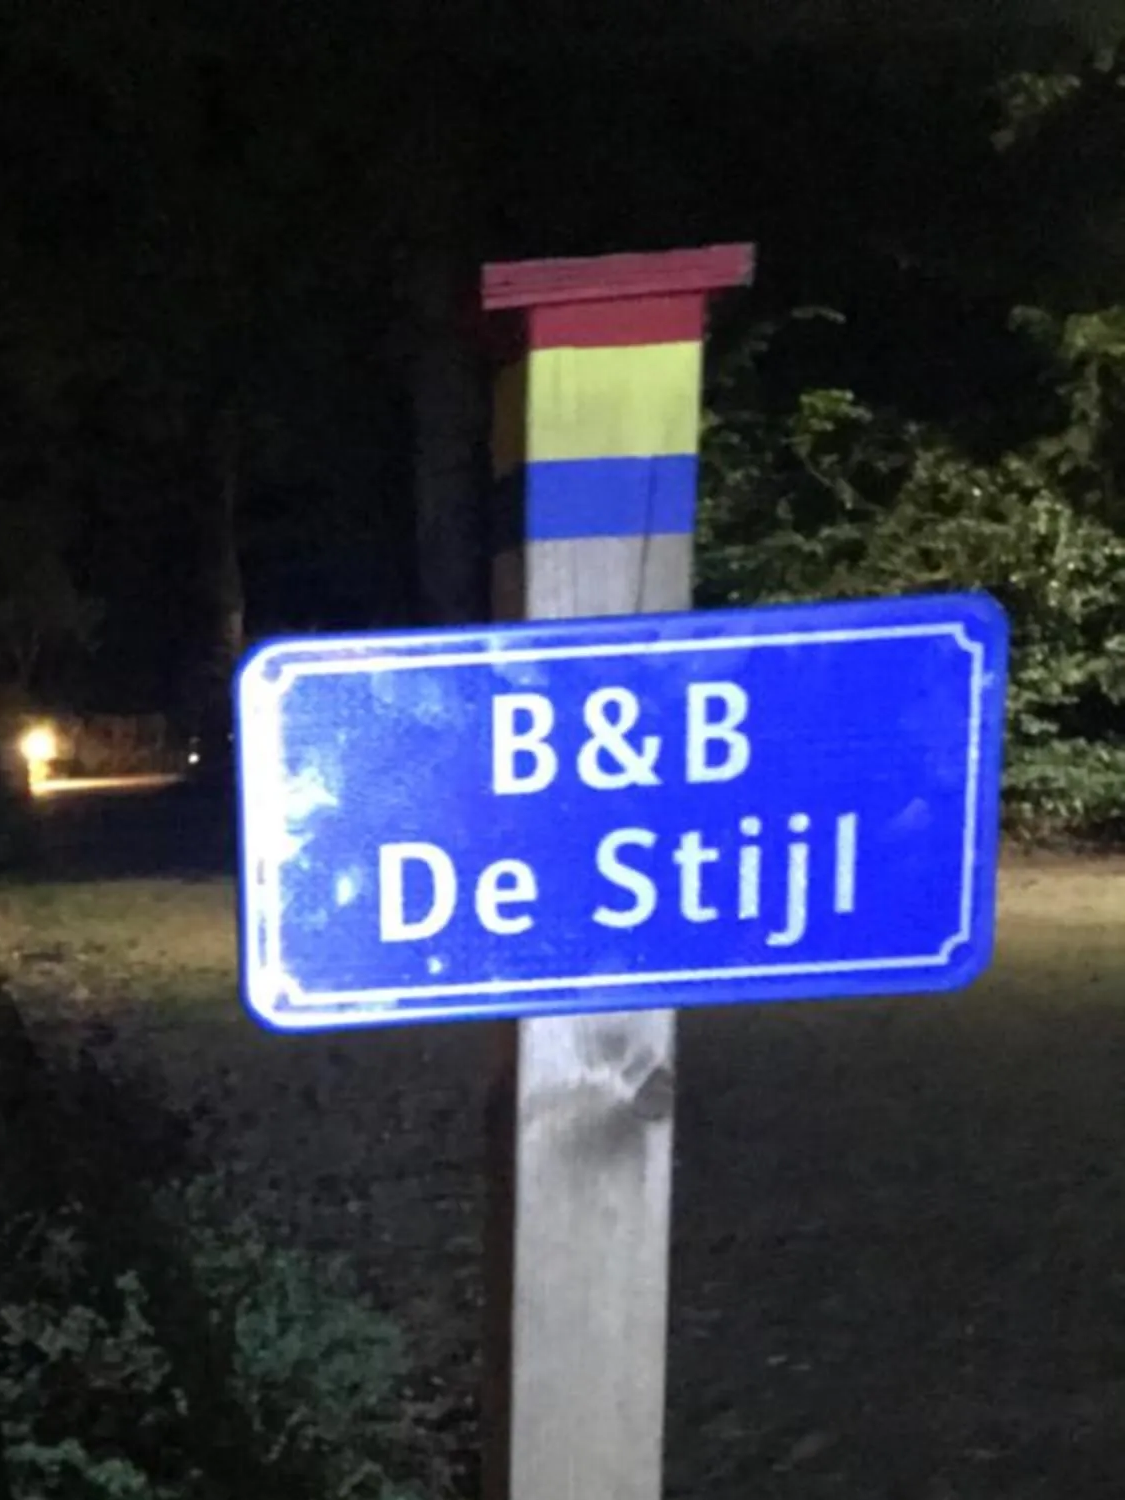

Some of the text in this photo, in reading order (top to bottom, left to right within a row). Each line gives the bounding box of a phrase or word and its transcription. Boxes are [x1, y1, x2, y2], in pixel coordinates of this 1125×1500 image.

[491, 680, 751, 796] B&B
[377, 811, 858, 948] De Stijl
